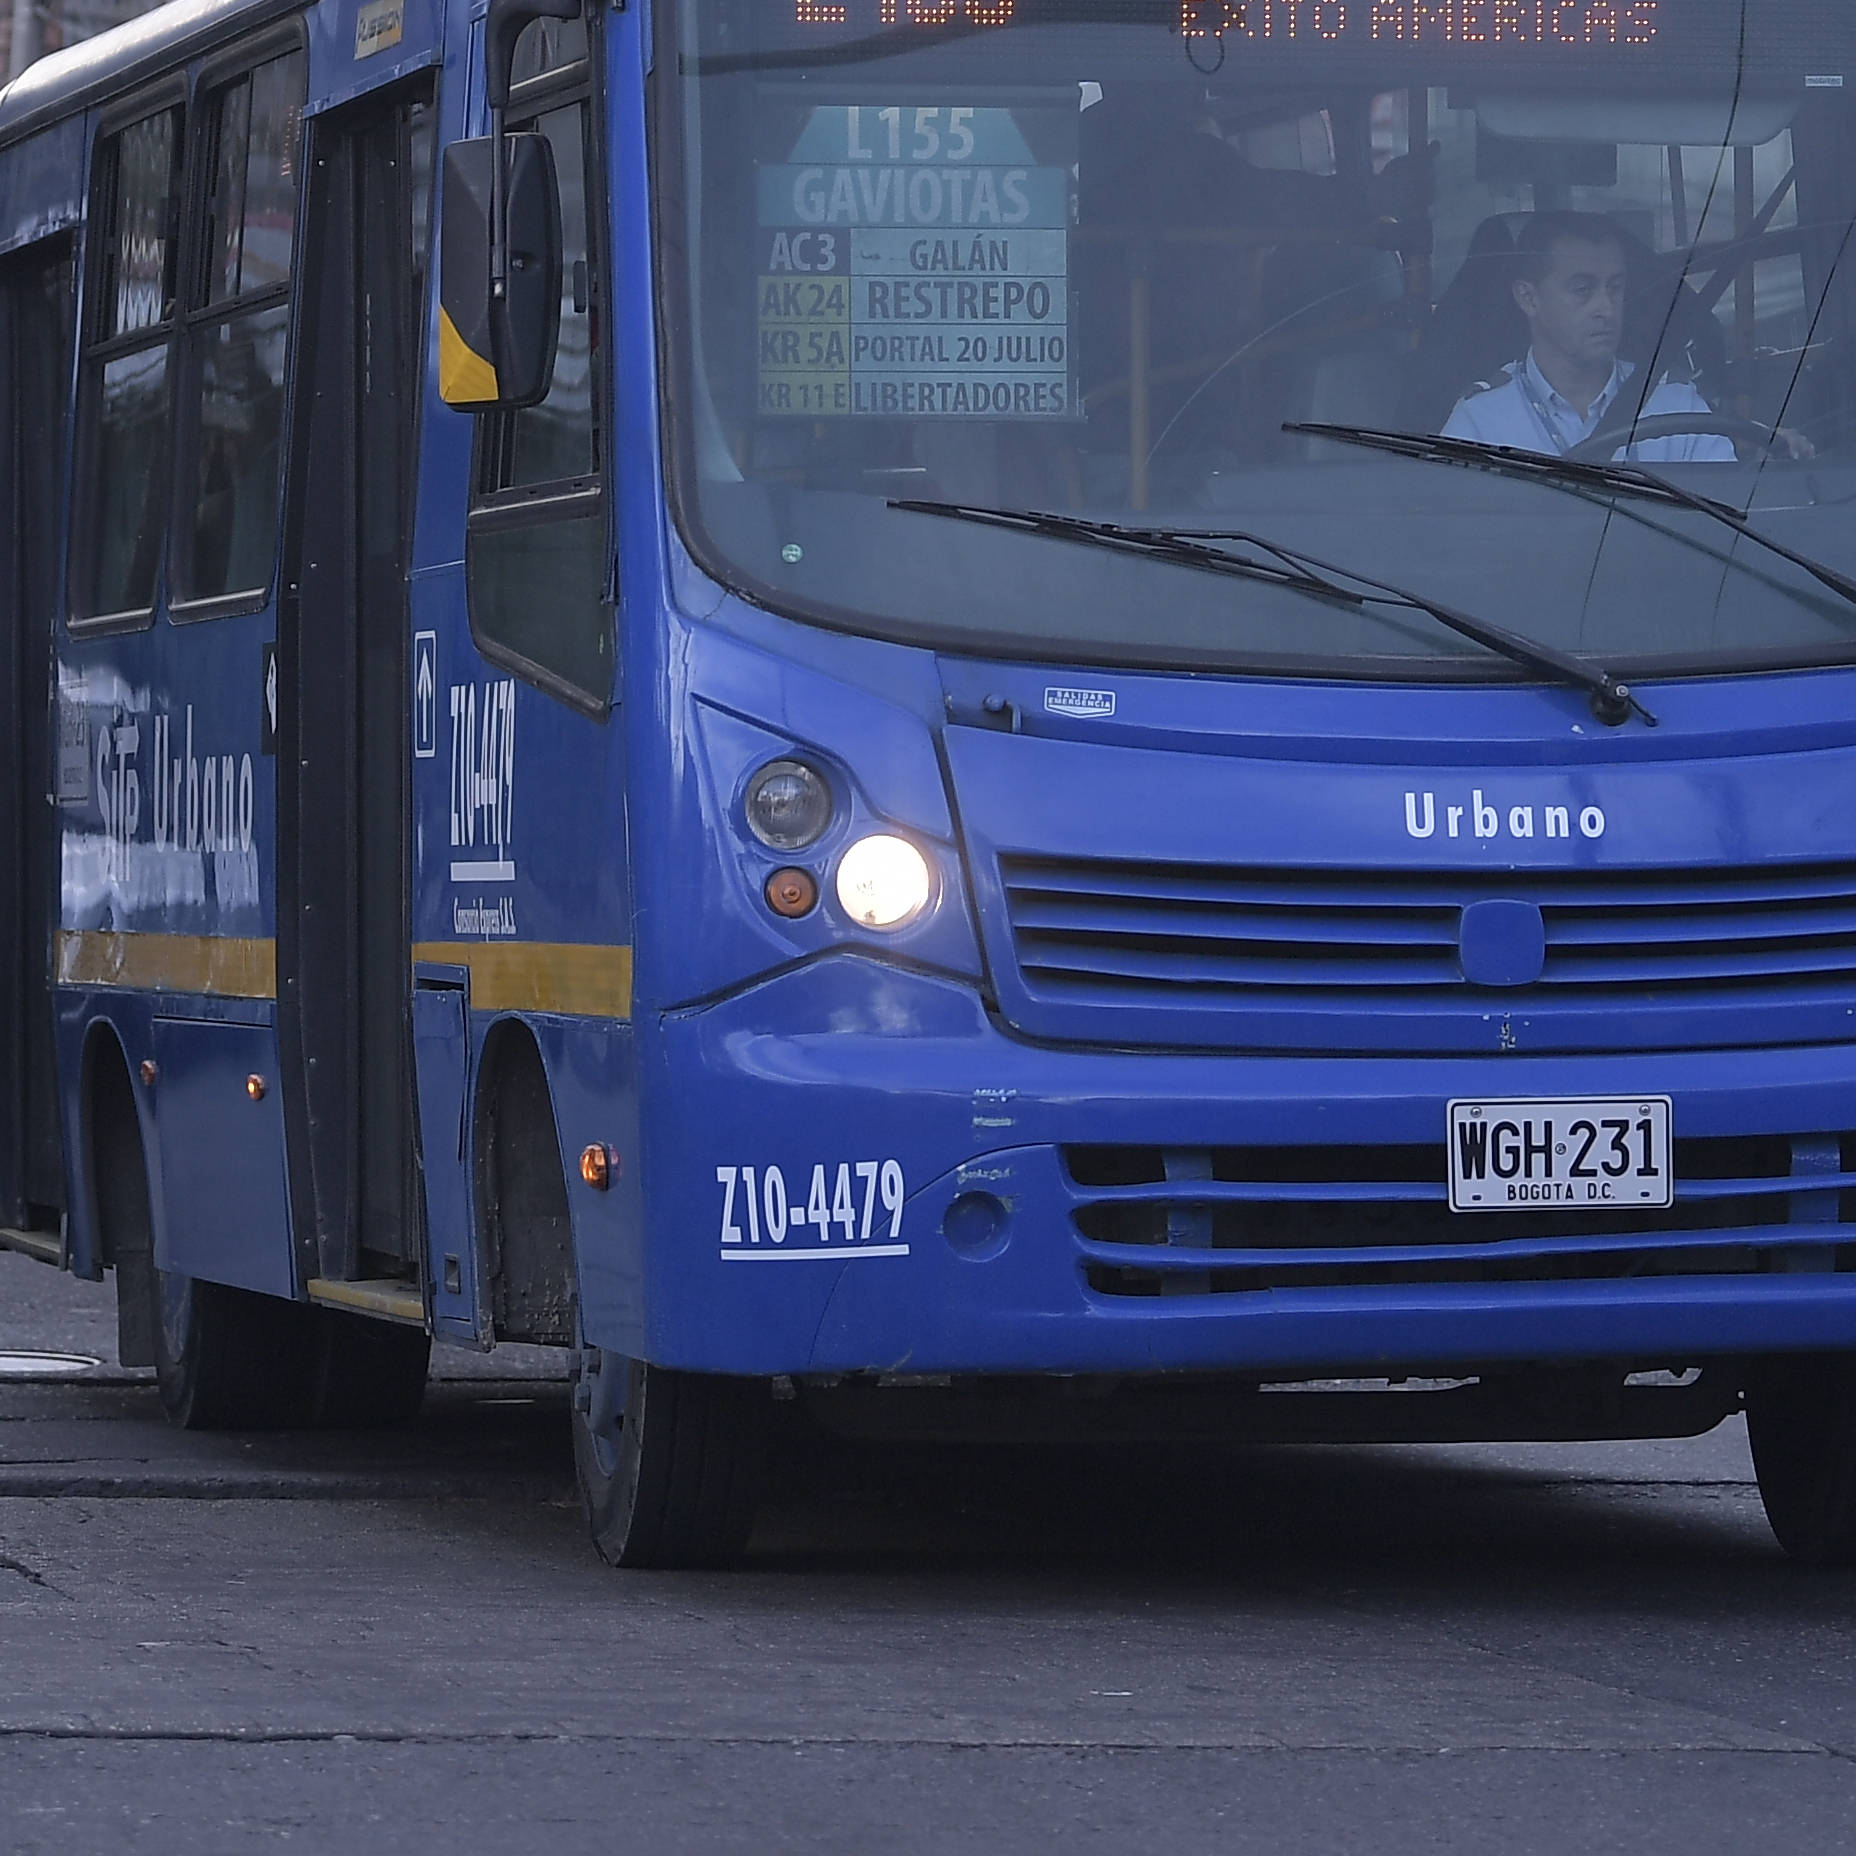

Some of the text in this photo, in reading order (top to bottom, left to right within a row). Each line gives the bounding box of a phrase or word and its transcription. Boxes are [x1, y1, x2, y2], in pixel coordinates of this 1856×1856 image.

[848, 106, 975, 160] L155
[794, 168, 1030, 224] GAVIOTAS
[909, 233, 1009, 272] GALÁN
[808, 283, 845, 317] 24
[867, 280, 1051, 320] RESTREPO
[853, 335, 950, 364] PORTAL
[956, 336, 989, 364] 20
[993, 336, 1065, 364] JULIO
[853, 382, 1065, 414] LIBERTADORES
[1048, 697, 1111, 708] EMERGENCIA
[1056, 691, 1103, 701] SALIDAS
[154, 704, 253, 853] Urbano
[1404, 789, 1605, 838] Urbano
[716, 1159, 904, 1243] Z10-4479
[1507, 1182, 1616, 1202] BOGOTA D.C.
